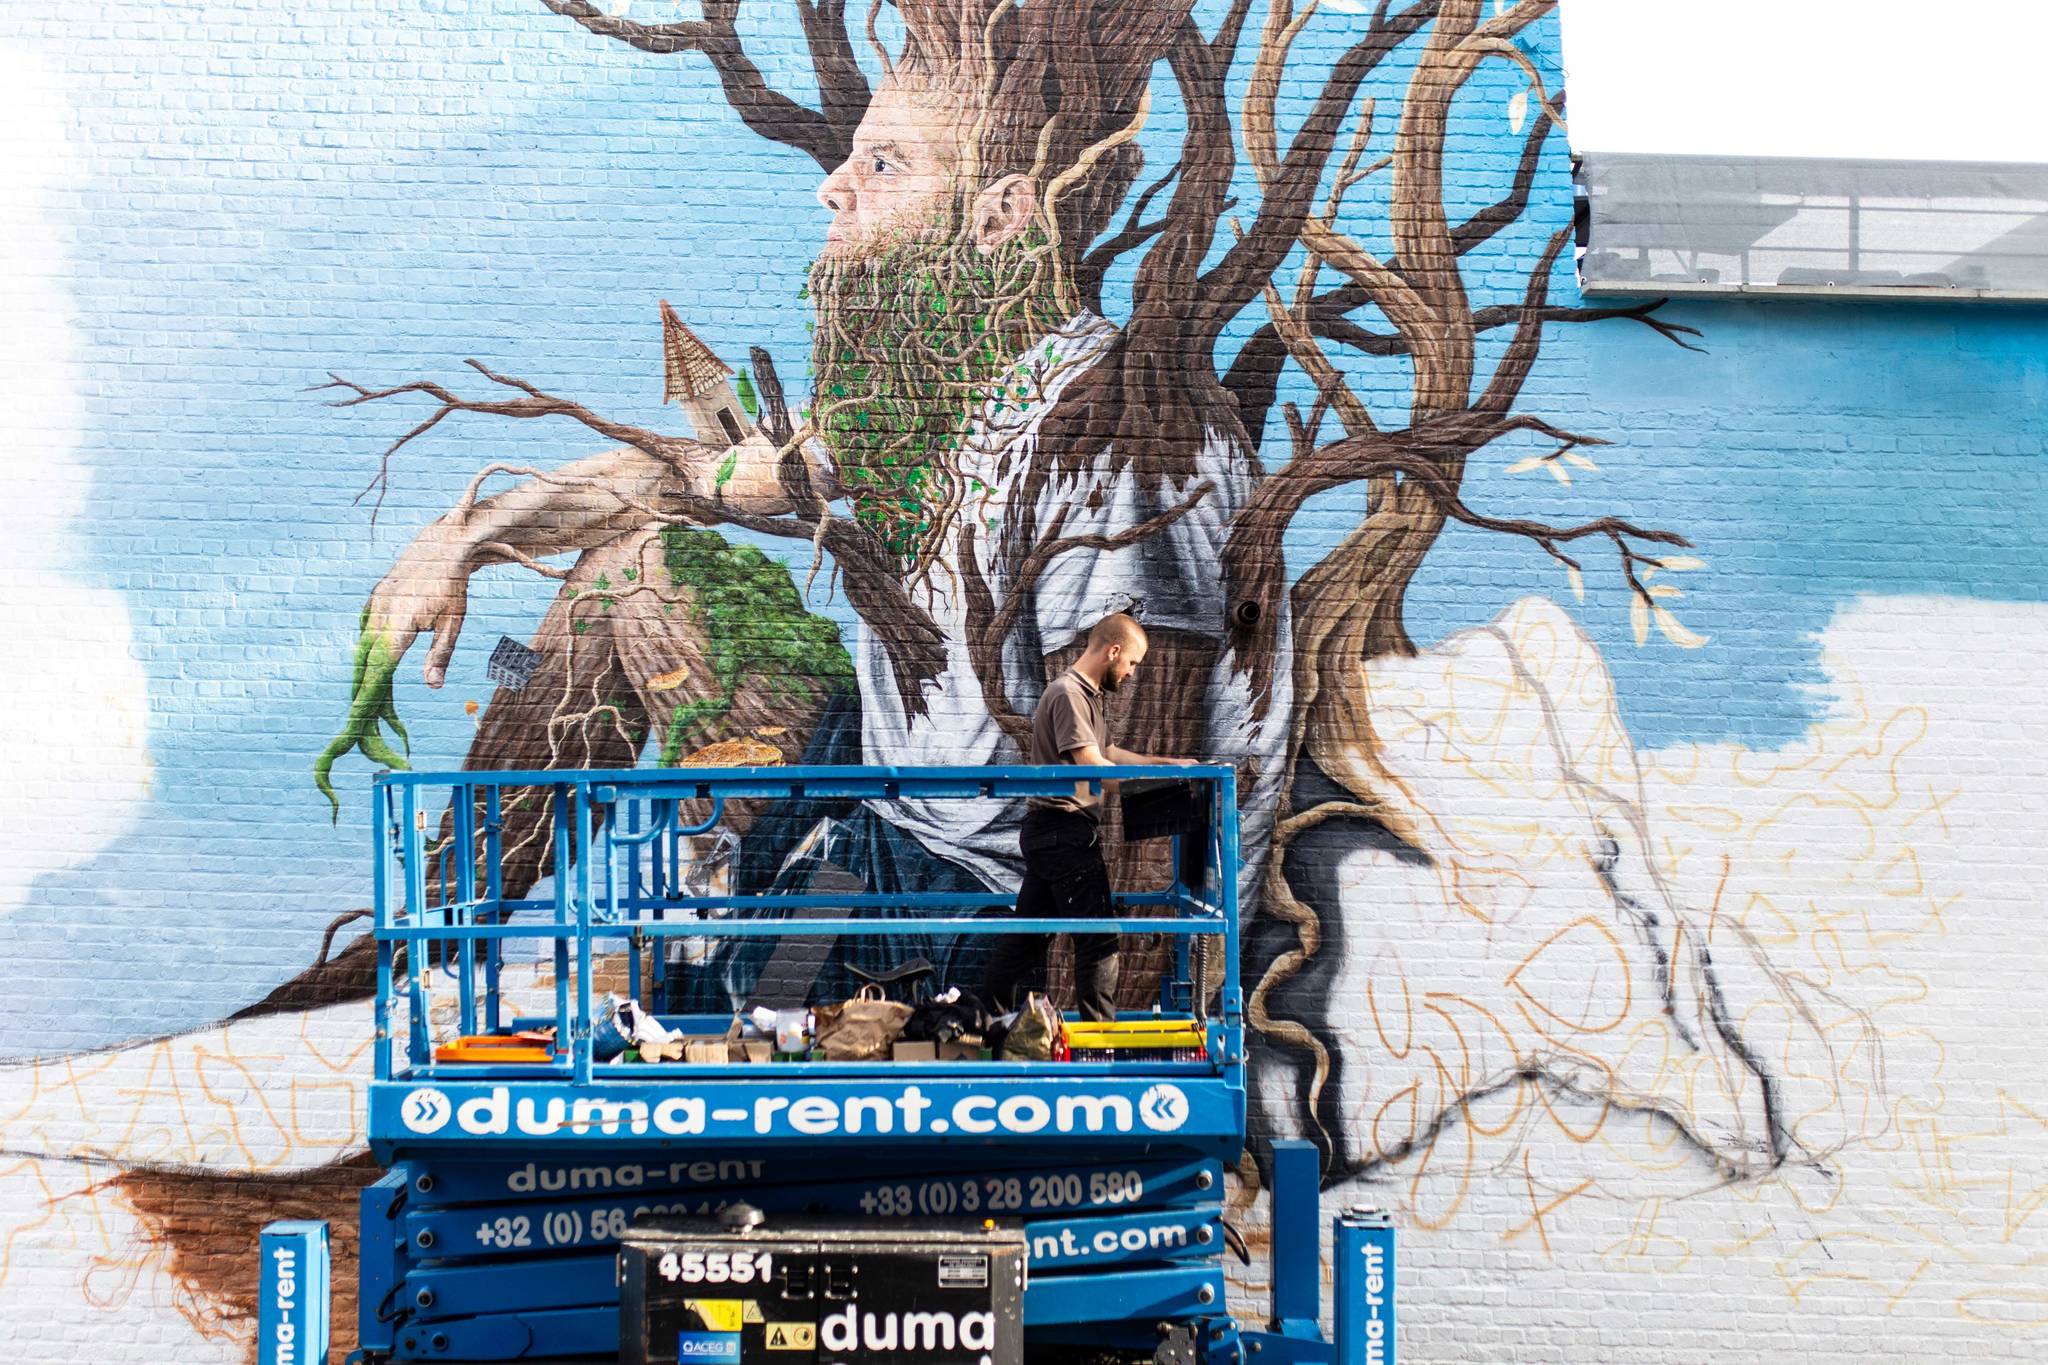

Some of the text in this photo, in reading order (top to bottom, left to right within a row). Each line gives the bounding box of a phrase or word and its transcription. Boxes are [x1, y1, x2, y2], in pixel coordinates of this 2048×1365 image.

[456, 1086, 1133, 1134] duma-rent.com
[507, 1160, 766, 1192] duma-rent
[860, 1170, 1143, 1216] +33 (0) 3 28 200 580
[476, 1215, 532, 1248] +32
[543, 1210, 583, 1246] (0)
[590, 1208, 627, 1240] 56
[1025, 1224, 1187, 1259] nt.com
[659, 1252, 772, 1284] 45551
[821, 1303, 994, 1351] duma
